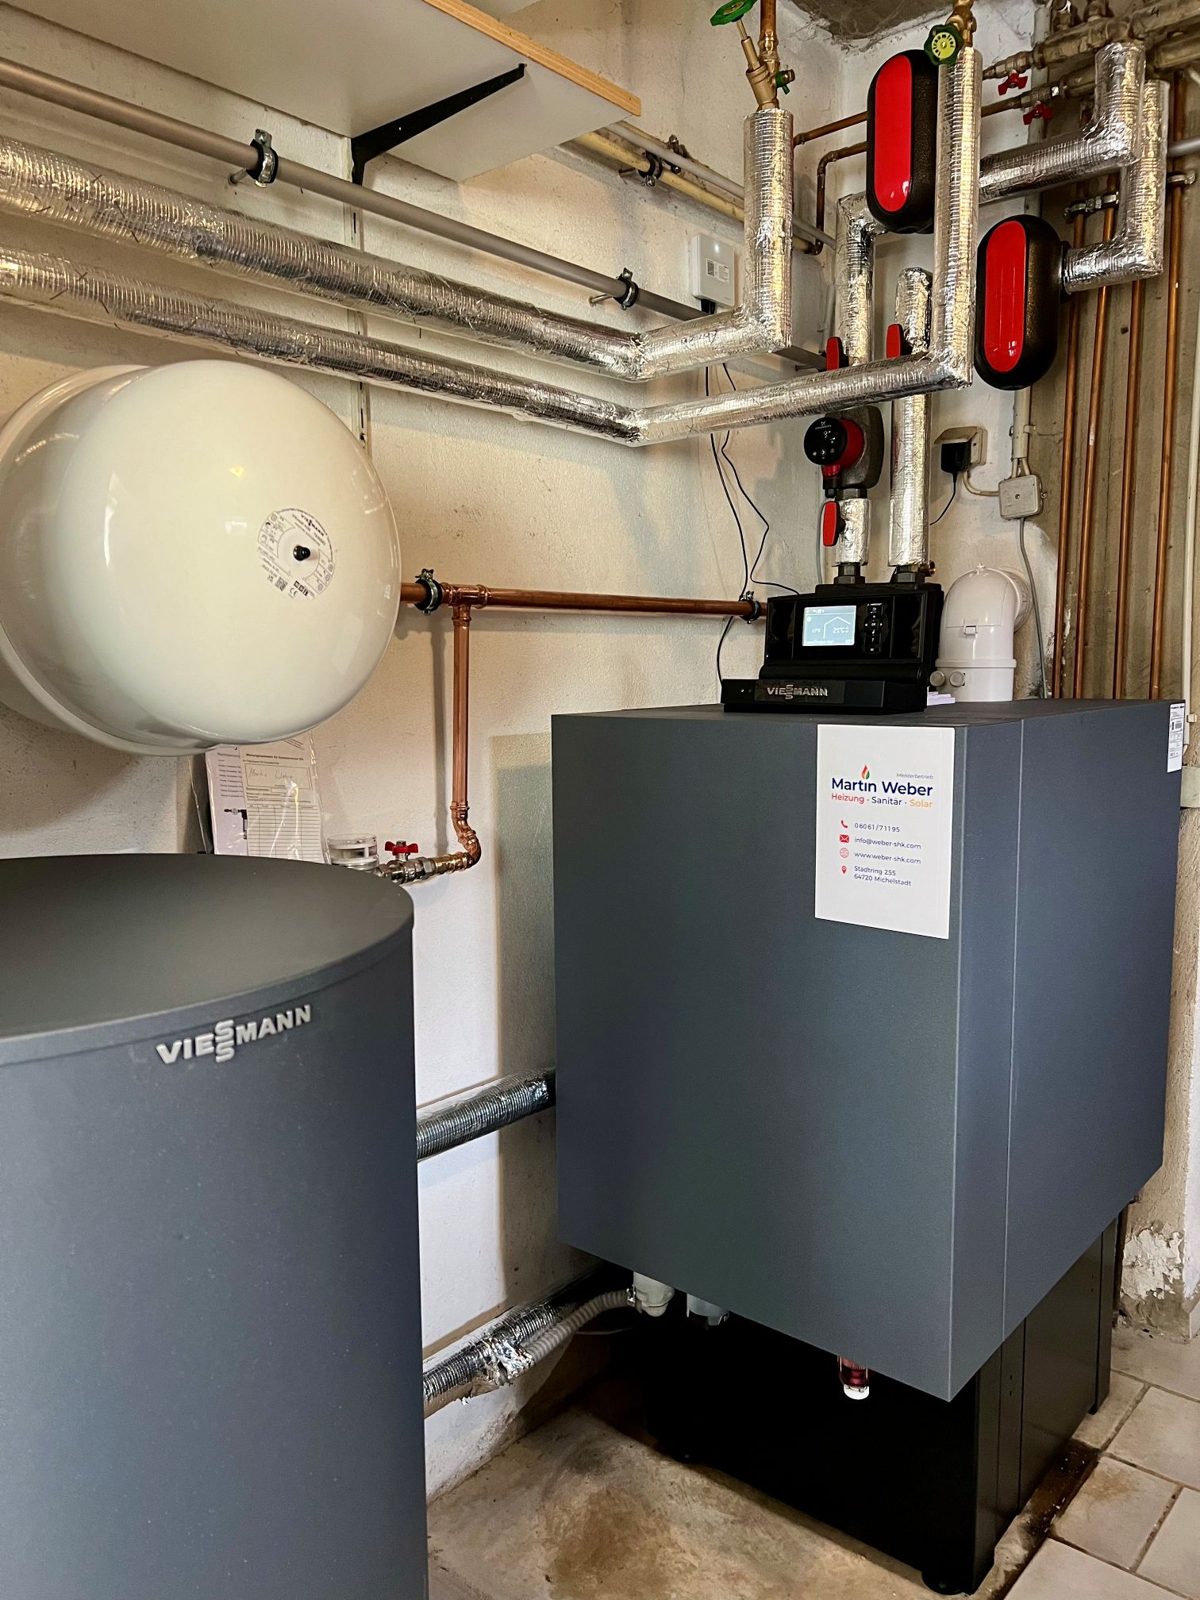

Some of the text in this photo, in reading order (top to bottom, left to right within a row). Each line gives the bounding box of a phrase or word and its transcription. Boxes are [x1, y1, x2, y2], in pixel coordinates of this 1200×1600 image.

[767, 684, 828, 700] VIESSMANN
[831, 777, 933, 797] Martin Weber
[831, 793, 865, 804] Heizung
[909, 798, 933, 808] Solar
[854, 822, 900, 832] 06061/71195
[854, 837, 921, 850] info@weber-shk.com
[854, 852, 921, 864] www.weber-shk.com
[854, 866, 883, 876] Stadtring
[854, 873, 912, 886] 64720 Michelstadt
[155, 1003, 312, 1064] VIESSMANN
